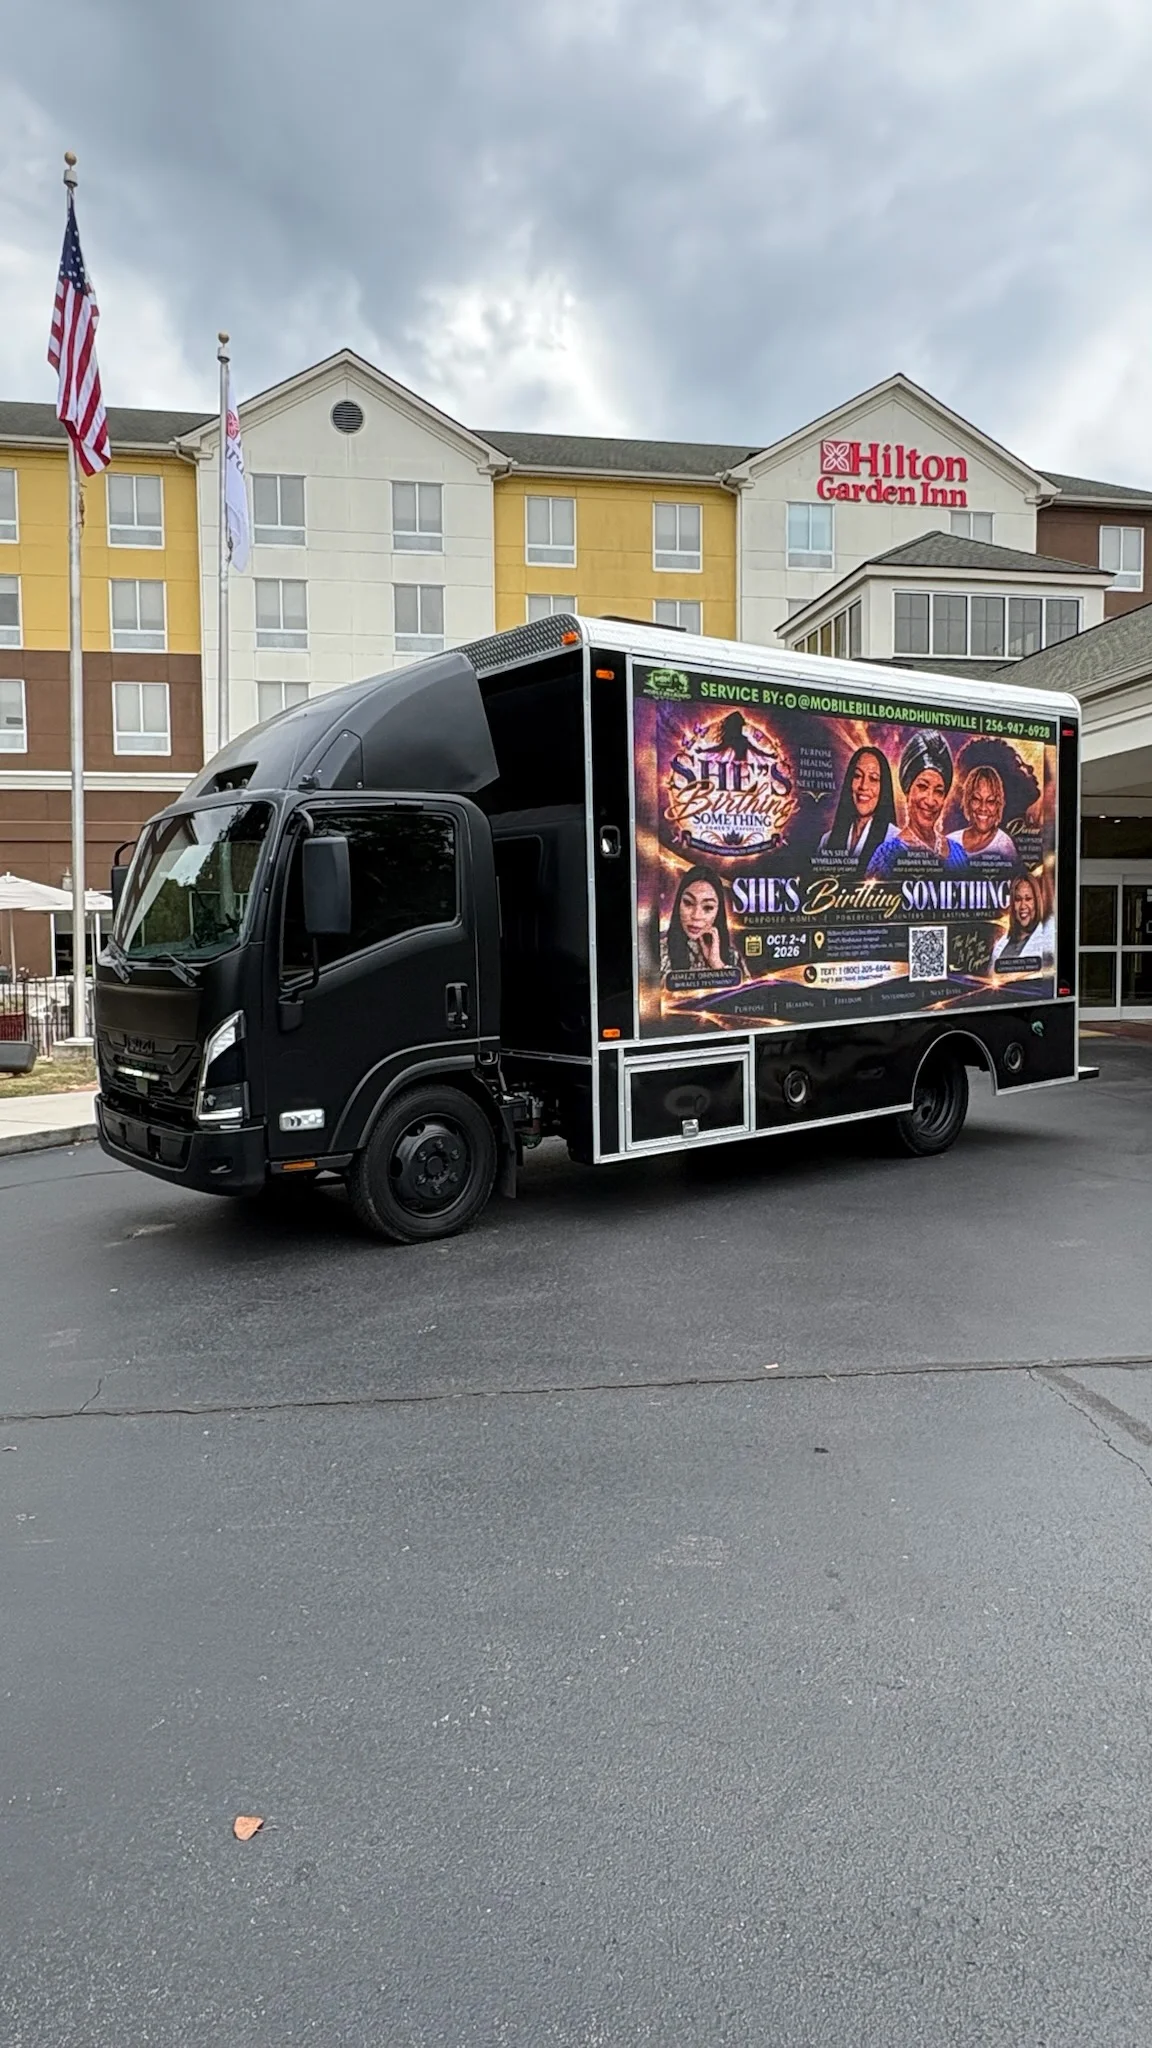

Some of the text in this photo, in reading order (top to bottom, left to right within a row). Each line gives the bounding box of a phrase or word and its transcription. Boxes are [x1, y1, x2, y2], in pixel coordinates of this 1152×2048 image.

[851, 442, 968, 482] Hilton
[817, 476, 968, 508] Garden Inn
[701, 682, 759, 703] SERVICE
[763, 689, 784, 706] BY:
[799, 695, 976, 730] @MOBILEBILLBOARDHUNTSVILLE
[985, 719, 1051, 739] 256-947-6928
[800, 758, 832, 768] HEALING
[664, 780, 801, 829] Birthing
[693, 813, 772, 827] SOMETHING
[732, 877, 1012, 918] SHE'S Birthing SOMETHING
[766, 933, 807, 946] OCT. 2-4
[773, 946, 800, 958] 2026
